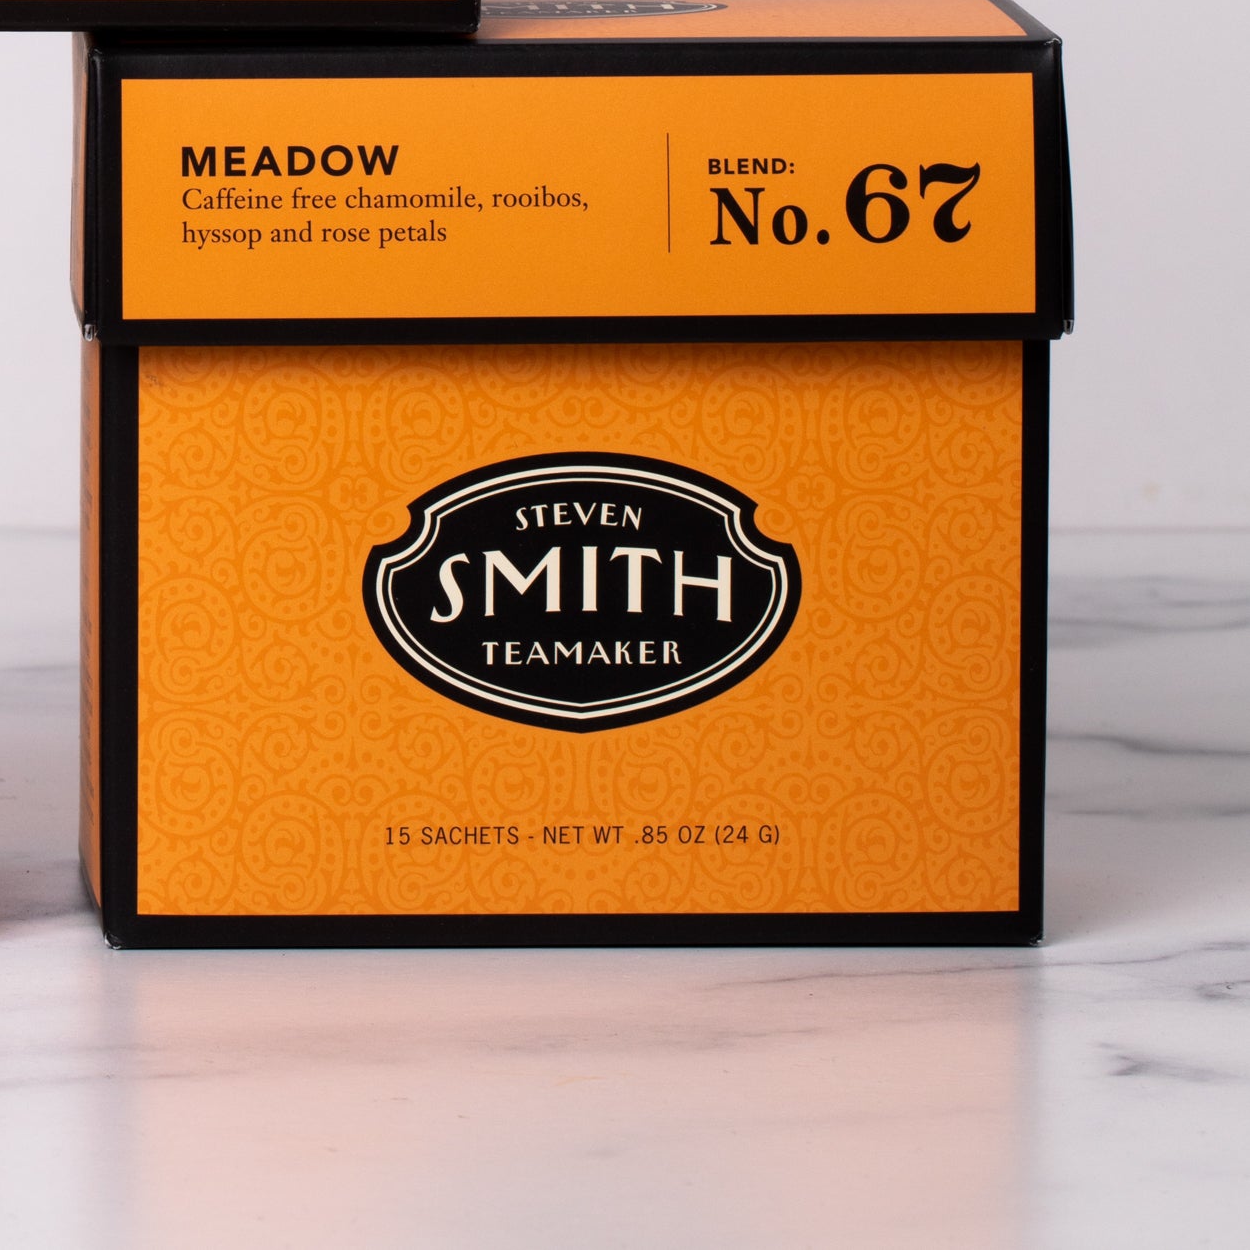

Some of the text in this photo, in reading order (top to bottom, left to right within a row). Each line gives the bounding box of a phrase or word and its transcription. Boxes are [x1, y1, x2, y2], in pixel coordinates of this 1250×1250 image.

[181, 144, 400, 178] MEADOW
[707, 157, 795, 176] BLEND:
[182, 184, 589, 213] Caffeine free chamomile, rooibos,
[181, 219, 447, 251] hyssop and rose petals
[515, 502, 642, 531] STEVEN
[429, 546, 734, 623] SMITH
[481, 640, 682, 665] TEAMAKER
[386, 826, 411, 846] 15
[421, 825, 519, 846] SACHETS
[543, 825, 585, 845] NET
[593, 825, 624, 844] WT
[634, 825, 668, 845] .85
[678, 825, 706, 844] OZ
[715, 824, 749, 846] (24
[758, 824, 780, 846] G)
